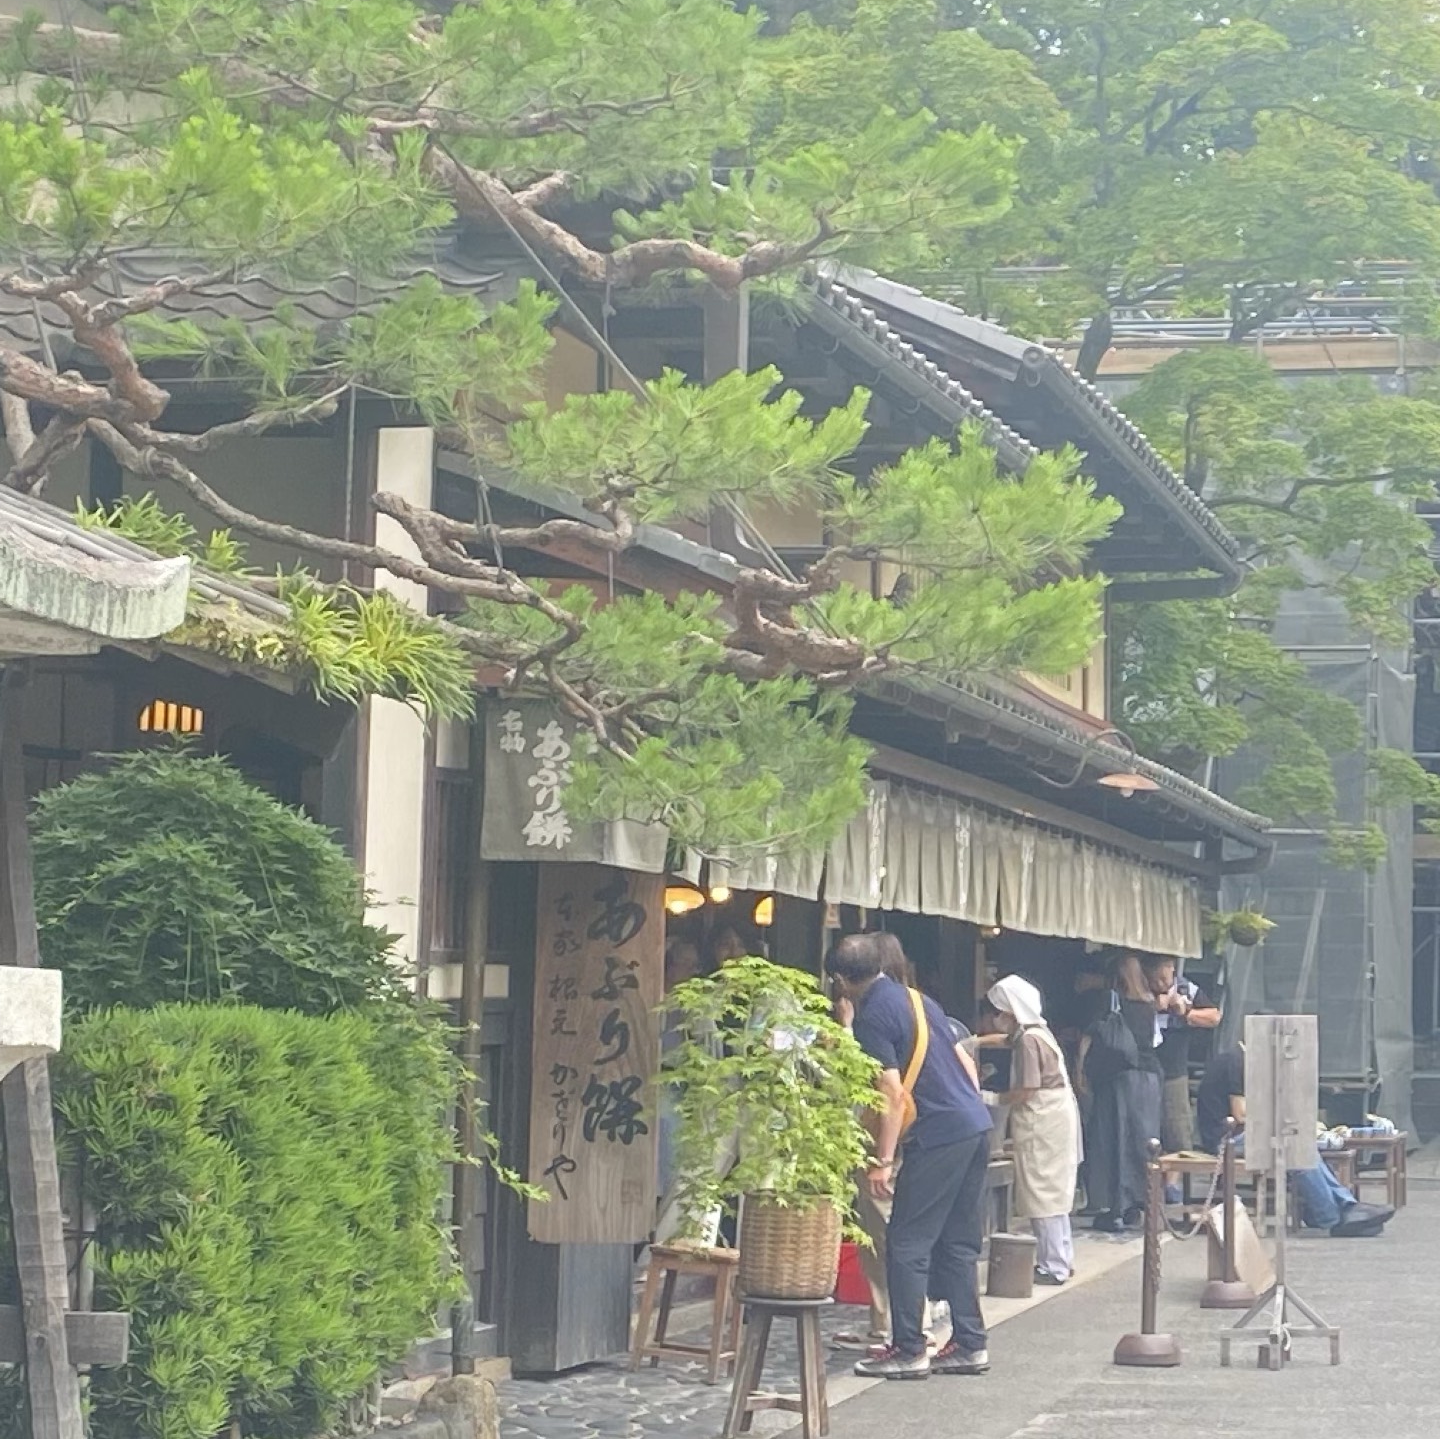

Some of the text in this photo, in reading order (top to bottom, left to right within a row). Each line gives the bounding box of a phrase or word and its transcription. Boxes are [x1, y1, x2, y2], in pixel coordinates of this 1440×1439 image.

[498, 710, 527, 754] 名物
[522, 720, 576, 851] あぶり餅
